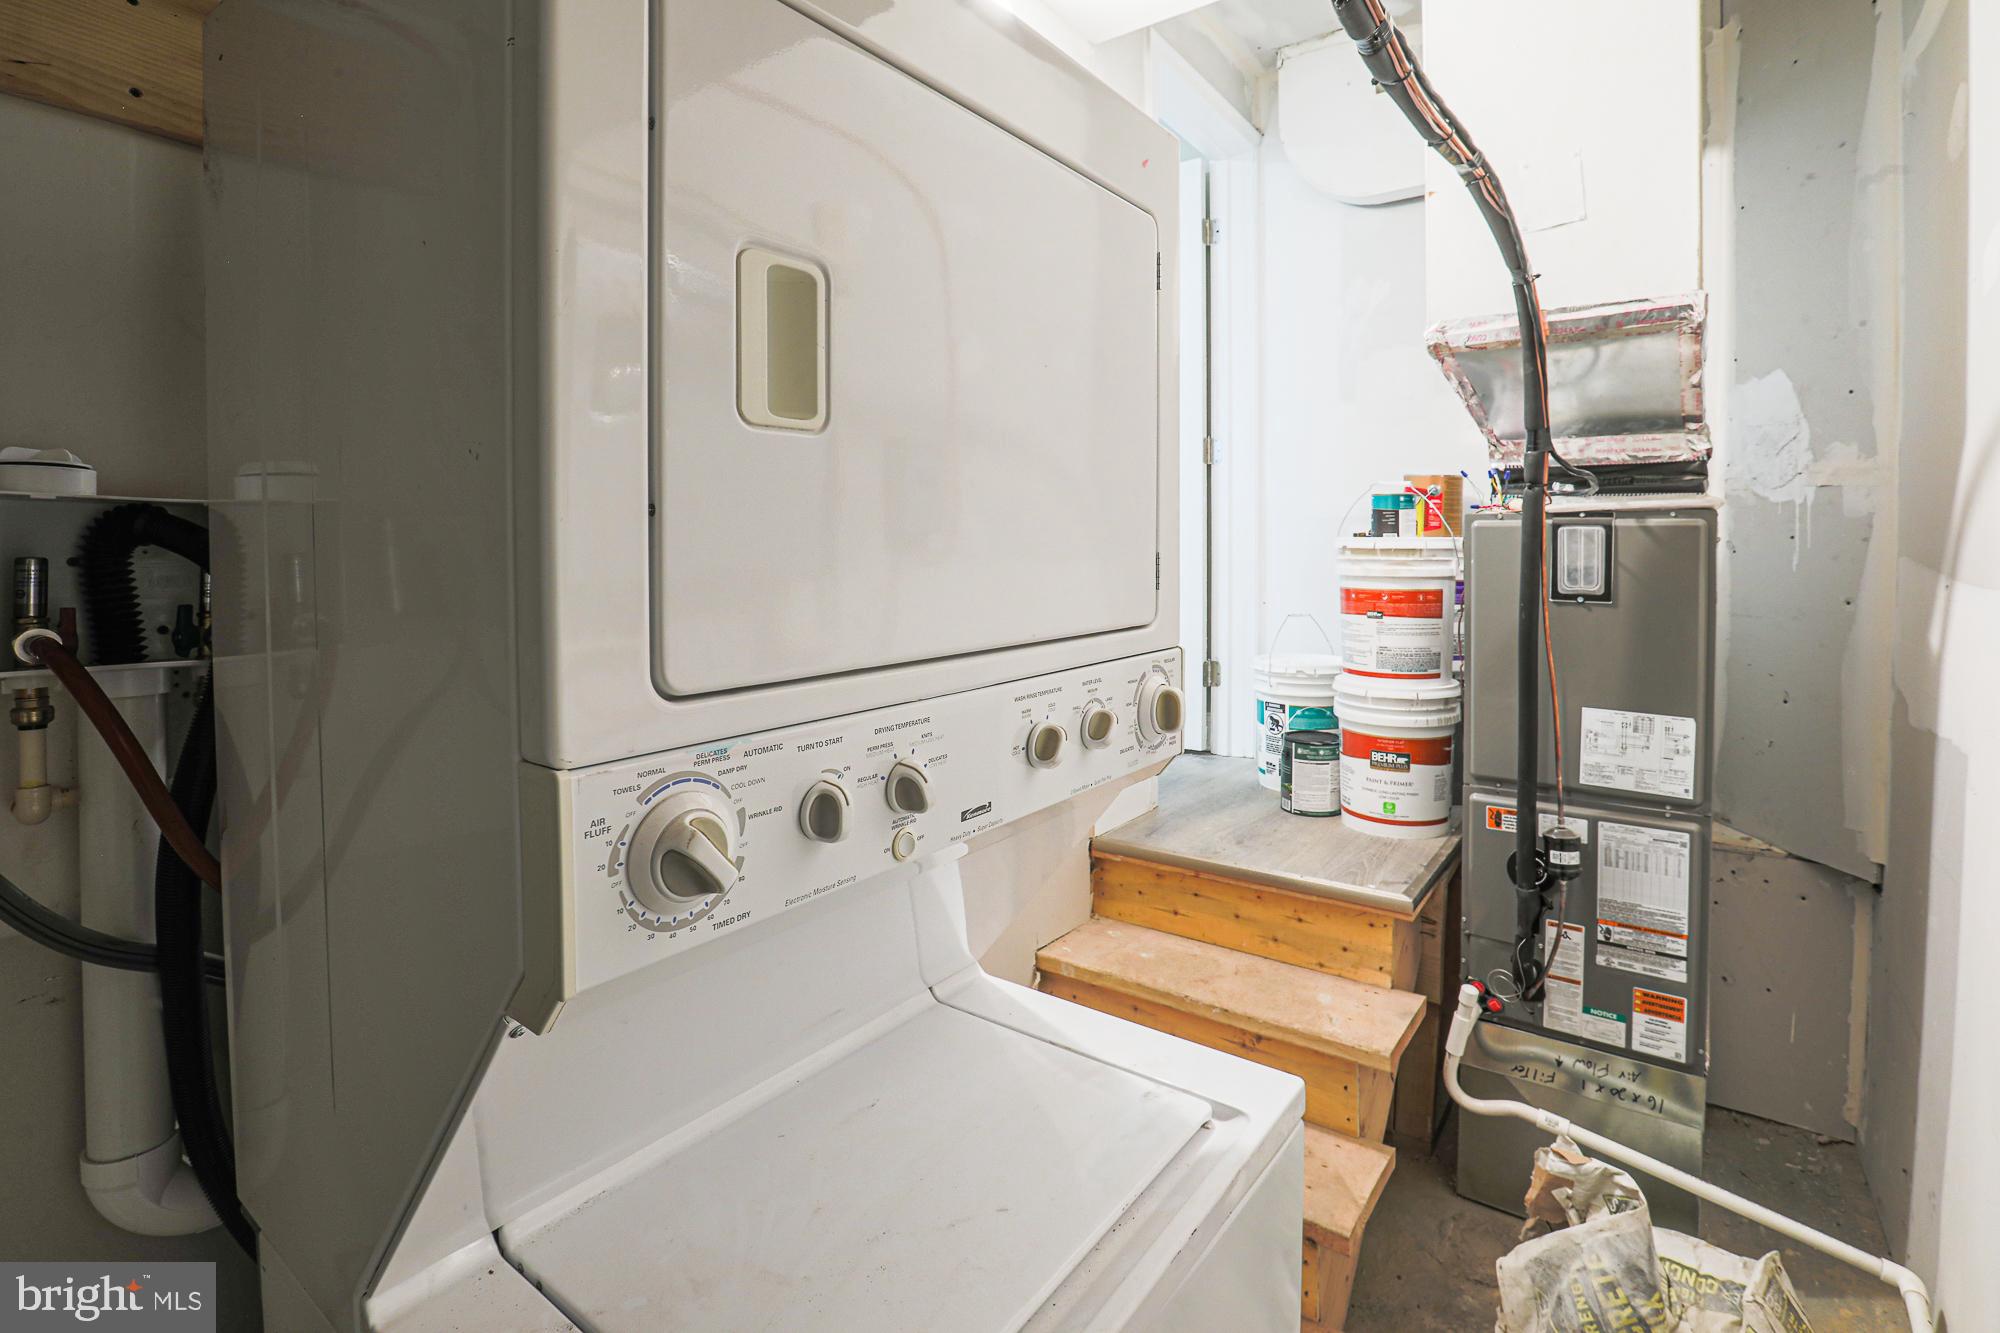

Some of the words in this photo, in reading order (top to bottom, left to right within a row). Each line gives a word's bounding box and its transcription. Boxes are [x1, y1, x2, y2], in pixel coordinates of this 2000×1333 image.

[874, 724, 895, 735] DRYING
[895, 717, 931, 730] TEMPERATURE
[743, 743, 784, 758] AUTOMATIC
[797, 742, 816, 753] TURN
[815, 740, 824, 749] TO
[824, 736, 843, 748] START
[696, 748, 728, 760] DELICATES
[1371, 751, 1397, 763] BEHR
[693, 758, 711, 768] PERM
[711, 755, 731, 765] PRESS
[637, 767, 666, 778] NORMAL
[717, 767, 734, 777] DAMP
[734, 764, 748, 774] DRY
[731, 781, 747, 791] COOL
[747, 777, 766, 787] DOWN
[857, 773, 878, 783] REGULAR
[613, 784, 641, 796] TOWELS
[625, 810, 636, 818] OFF
[748, 809, 769, 820] WRINKLE
[769, 805, 783, 815] RID
[590, 817, 606, 828] AIR
[584, 826, 612, 840] FLUFF
[597, 863, 606, 872] 20
[611, 880, 622, 889] OFF
[813, 883, 836, 896] Moisture
[712, 917, 735, 931] TIMED
[735, 910, 752, 925] DRY
[628, 924, 637, 932] 20
[647, 933, 655, 941] 30
[1642, 991, 1684, 1006] WARNING
[1590, 1008, 1618, 1020] NOTICE
[1573, 1058, 1610, 1078] Flow
[1610, 1087, 1626, 1101] 20
[1647, 1095, 1664, 1114] 16
